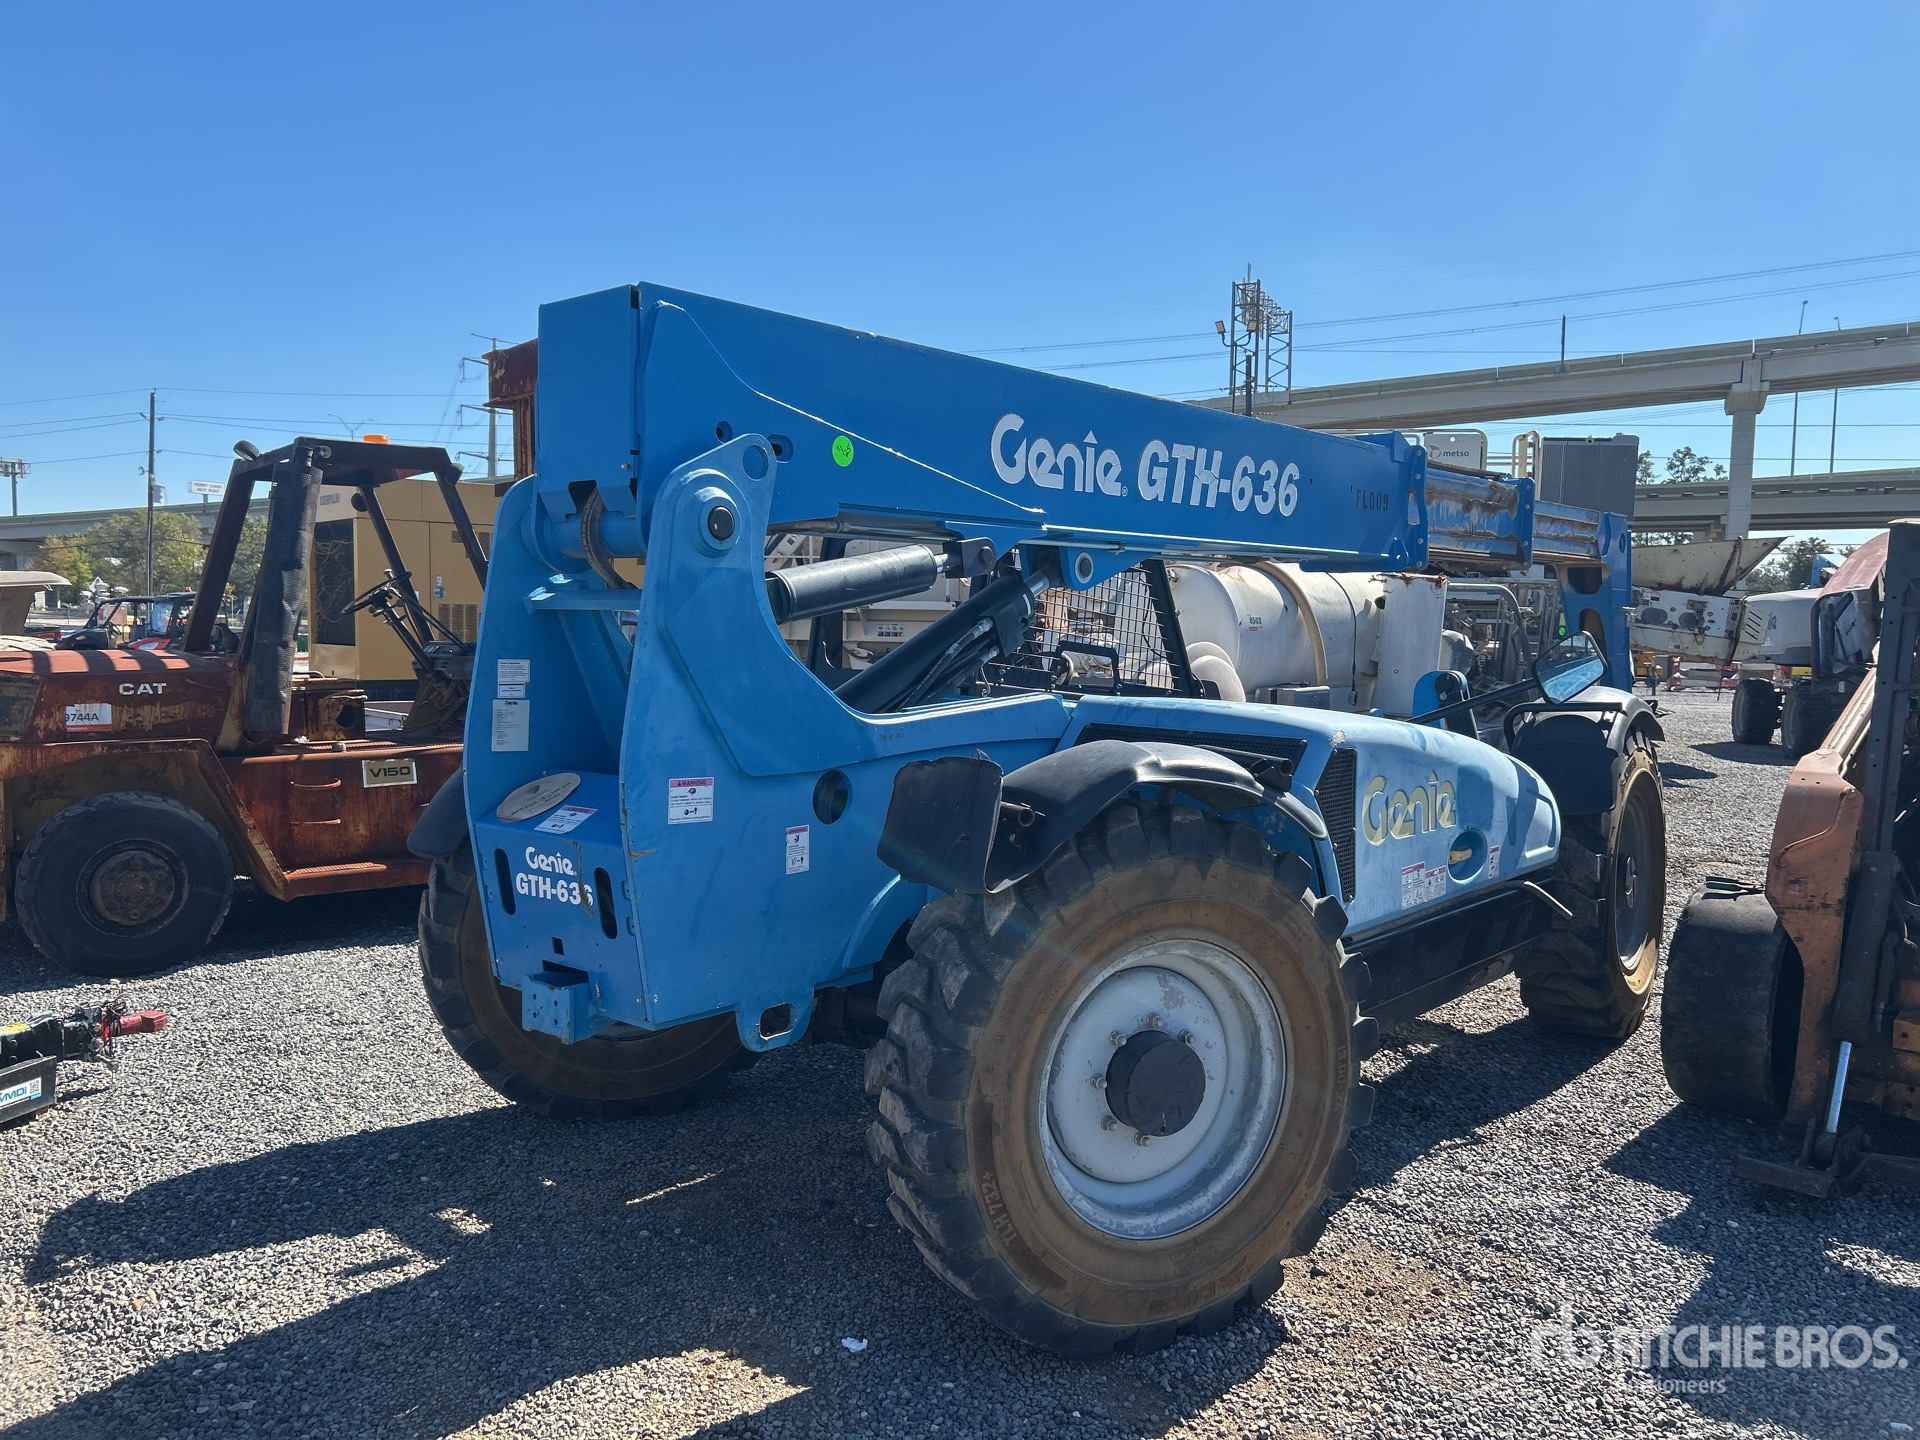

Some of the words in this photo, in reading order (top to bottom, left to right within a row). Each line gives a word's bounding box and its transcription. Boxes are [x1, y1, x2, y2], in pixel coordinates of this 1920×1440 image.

[1442, 449, 1470, 457] metso
[1137, 440, 1300, 517] GTH-636
[1355, 488, 1389, 512] FL009
[118, 682, 167, 696] CAT
[369, 766, 411, 778] V150
[1362, 769, 1457, 847] Genie
[525, 846, 574, 876] Genie
